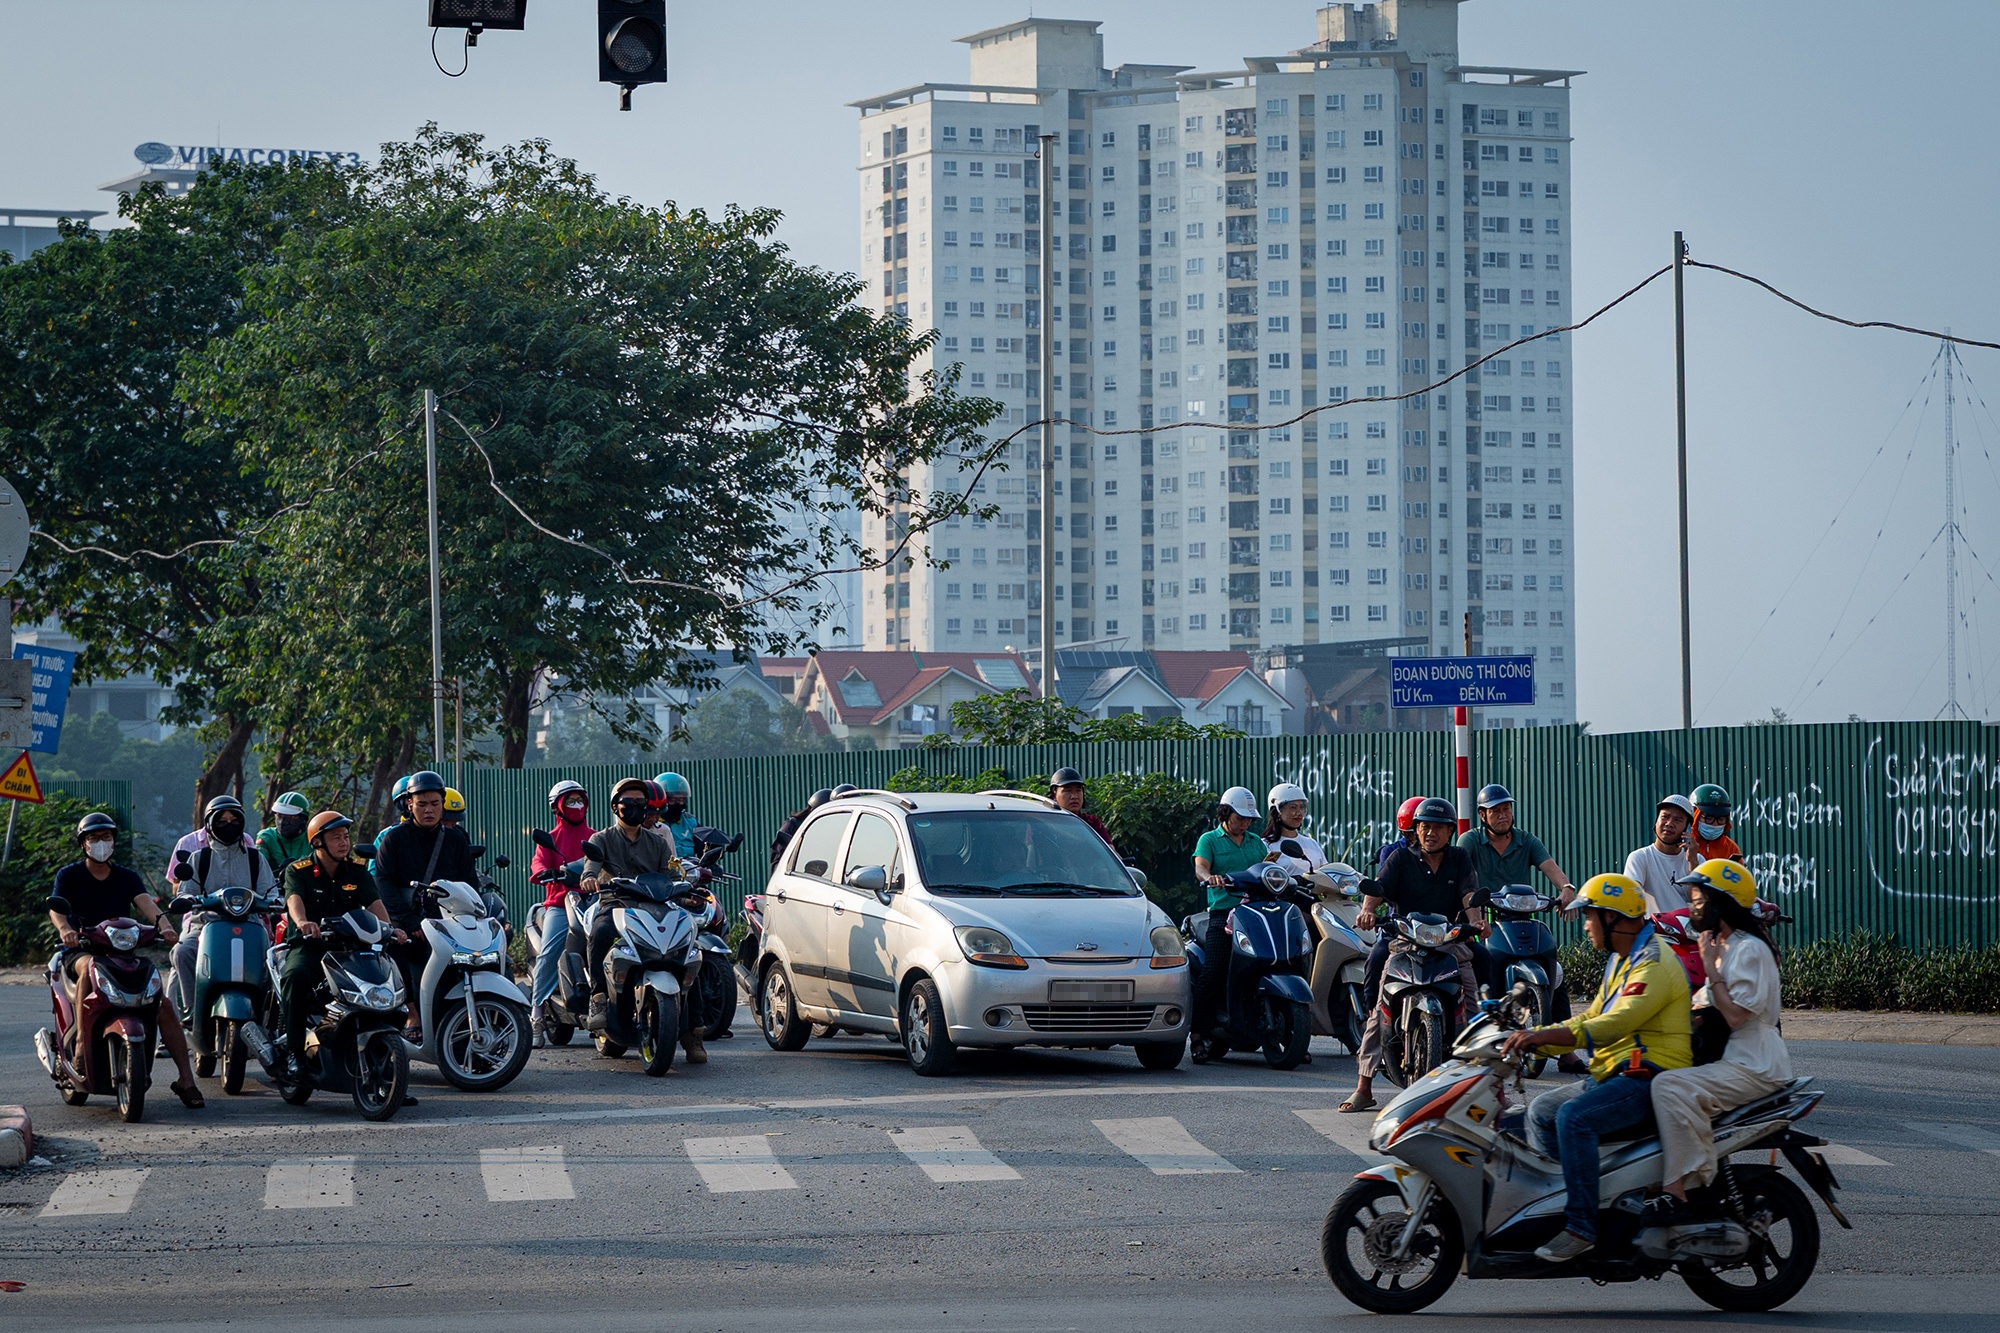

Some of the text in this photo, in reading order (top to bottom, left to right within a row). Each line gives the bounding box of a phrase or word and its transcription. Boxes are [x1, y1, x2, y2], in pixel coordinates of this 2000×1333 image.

[1394, 660, 1532, 683] ĐOẠN ĐƯỜNG THI CÔNG
[32, 672, 53, 689] HEAD
[1394, 681, 1507, 703] TỪ Km ĐẾN Km
[17, 767, 27, 779] ĐI
[4, 779, 32, 795] CHẬM
[1721, 865, 1742, 884] be
[1602, 881, 1623, 898] be
